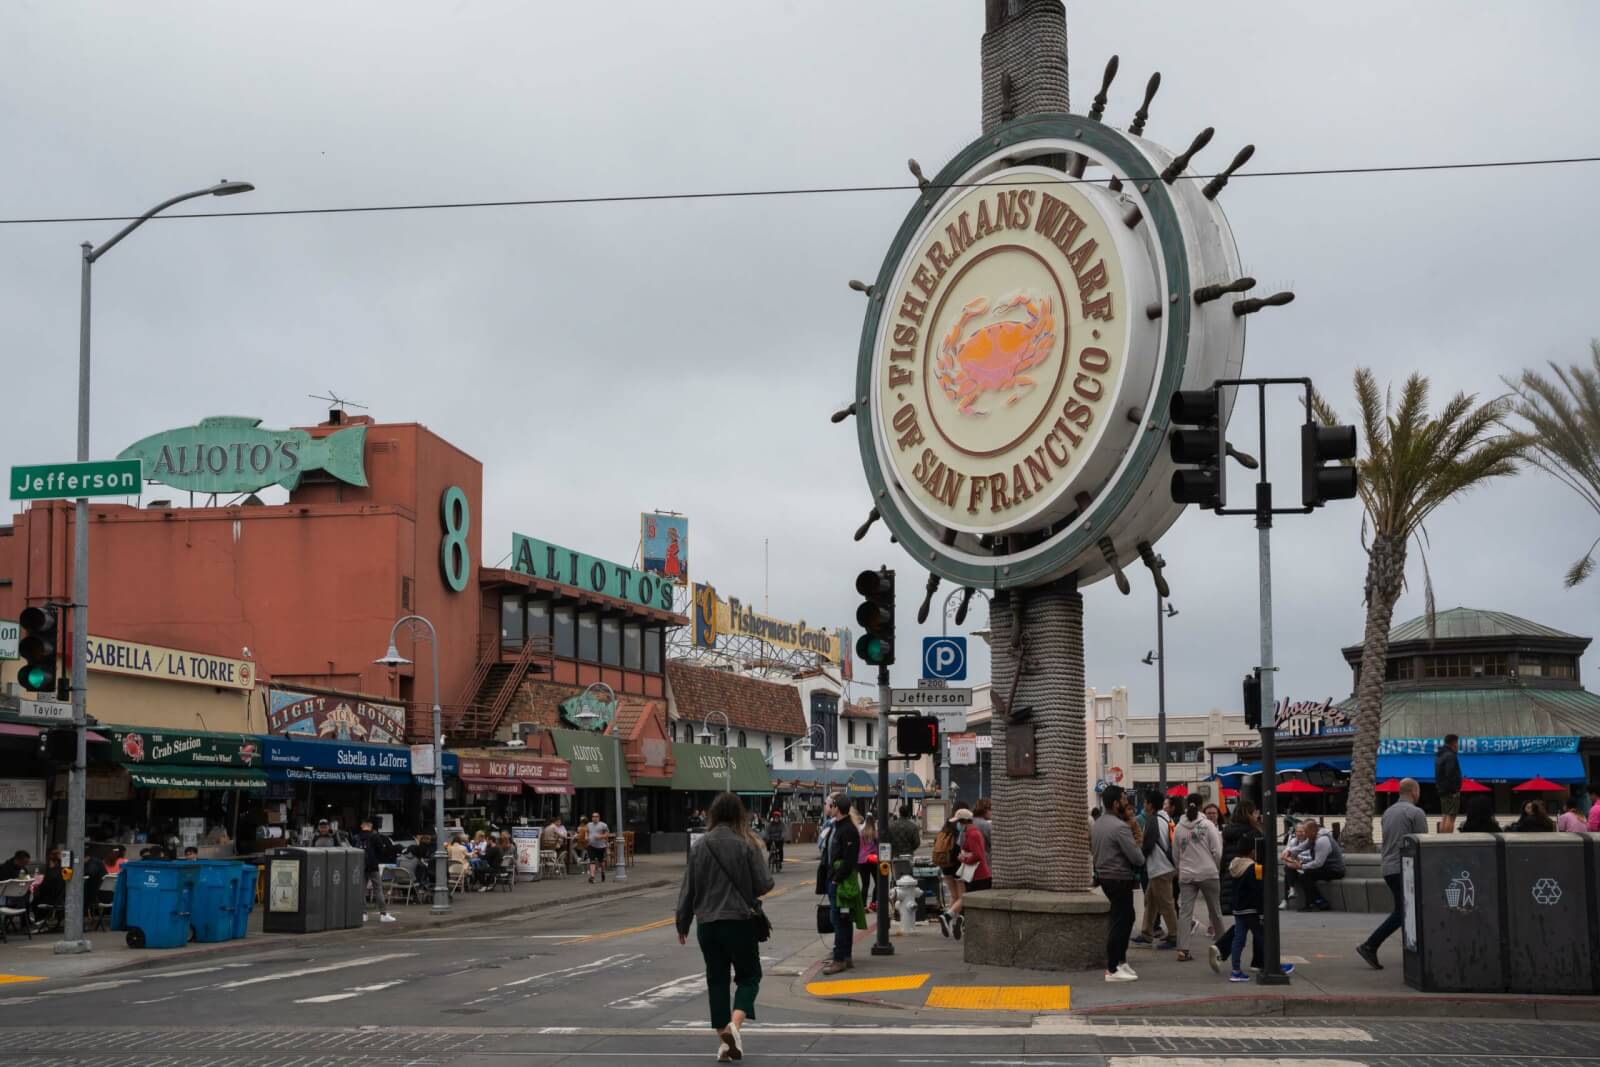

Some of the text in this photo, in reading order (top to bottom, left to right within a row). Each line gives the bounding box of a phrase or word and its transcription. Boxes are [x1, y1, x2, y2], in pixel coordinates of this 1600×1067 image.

[888, 190, 1114, 389] FISHERMANS WHARF
[892, 347, 1111, 514] OF SAN FRANCISCO
[153, 440, 300, 476] ALIOTO'S
[17, 472, 134, 492] Jefferson
[439, 486, 470, 593] 8
[516, 538, 674, 611] ALIOTO'S
[86, 641, 152, 673] SABELLA
[168, 654, 186, 676] LA
[190, 657, 235, 682] TORRE
[33, 704, 63, 716] Taylor
[271, 698, 326, 729] LIGHT
[899, 693, 965, 703] Jefferson
[357, 703, 404, 739] HOUSE
[1289, 716, 1322, 736] HUT
[152, 737, 201, 760] Crab Station
[337, 750, 407, 768] Sabella & LaTorre
[1377, 739, 1430, 754] HAPPY
[1481, 739, 1519, 751] 3-5PM
[1521, 738, 1575, 749] WEEKDAYS
